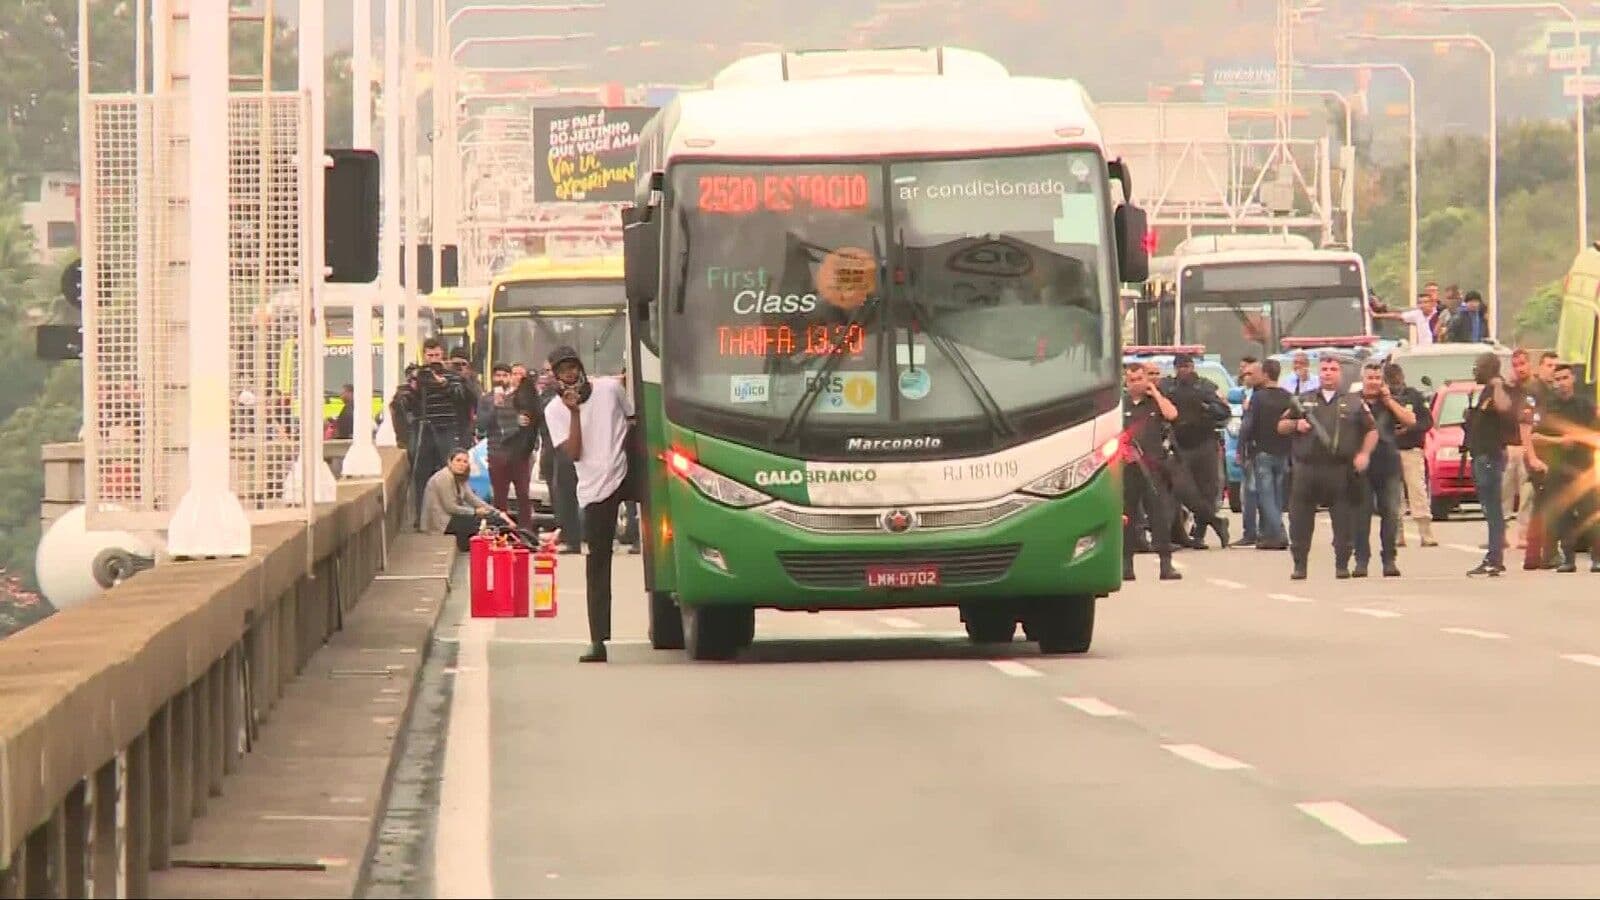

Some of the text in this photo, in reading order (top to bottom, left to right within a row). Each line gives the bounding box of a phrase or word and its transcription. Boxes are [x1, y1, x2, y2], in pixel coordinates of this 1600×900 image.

[549, 131, 569, 146] DO
[549, 143, 576, 159] QUE
[698, 172, 868, 211] 2520 ESTACIO
[899, 178, 1066, 200] ar condicionado
[707, 265, 768, 289] First
[733, 289, 817, 315] Class
[848, 436, 942, 451] Marcopolo
[943, 465, 963, 481] RJ
